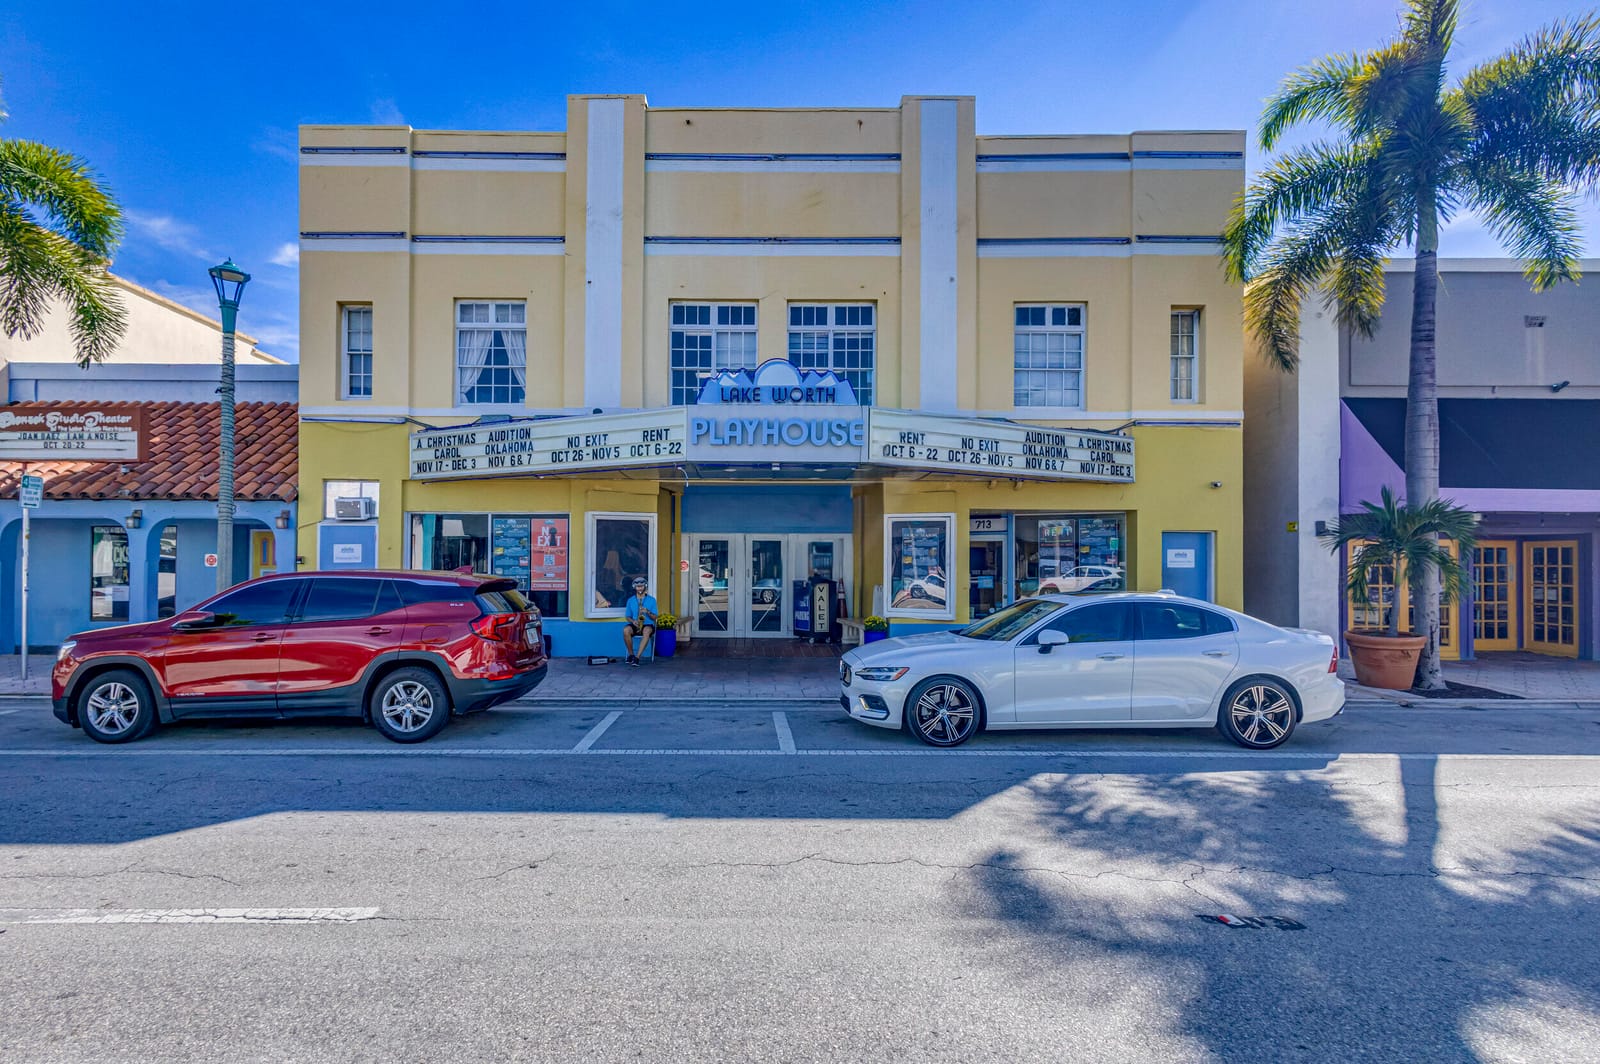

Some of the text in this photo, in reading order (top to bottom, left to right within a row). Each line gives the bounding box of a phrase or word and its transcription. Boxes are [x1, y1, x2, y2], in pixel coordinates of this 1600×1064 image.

[720, 387, 836, 403] LAKE WORTH
[488, 428, 531, 443] AUDITION
[642, 428, 670, 442] RENT
[691, 418, 865, 446] PLAYHOUSE
[899, 431, 926, 445] RENT
[1025, 431, 1066, 447] AUDITION
[44, 441, 58, 449] OCT
[417, 433, 476, 449] A CHRISTMAS
[567, 433, 609, 448] NO EXIT
[961, 437, 1000, 452] NO EXIT
[1078, 437, 1132, 453] A CHRISTMAS
[434, 447, 461, 460] CAROL
[485, 441, 534, 455] OKLAHOMA
[630, 444, 651, 457] OCT
[883, 444, 904, 458] OCT
[1022, 445, 1069, 459] OKLAHOMA
[488, 456, 505, 468] NOV
[551, 450, 570, 463] OCT
[948, 449, 967, 463] OCT
[1025, 457, 1043, 469] NOV
[1090, 451, 1116, 463] CAROL
[417, 461, 433, 473] NOV
[471, 458, 476, 469] 3
[1080, 463, 1096, 474] NOV
[1126, 466, 1131, 477] 3
[975, 519, 992, 529] 713
